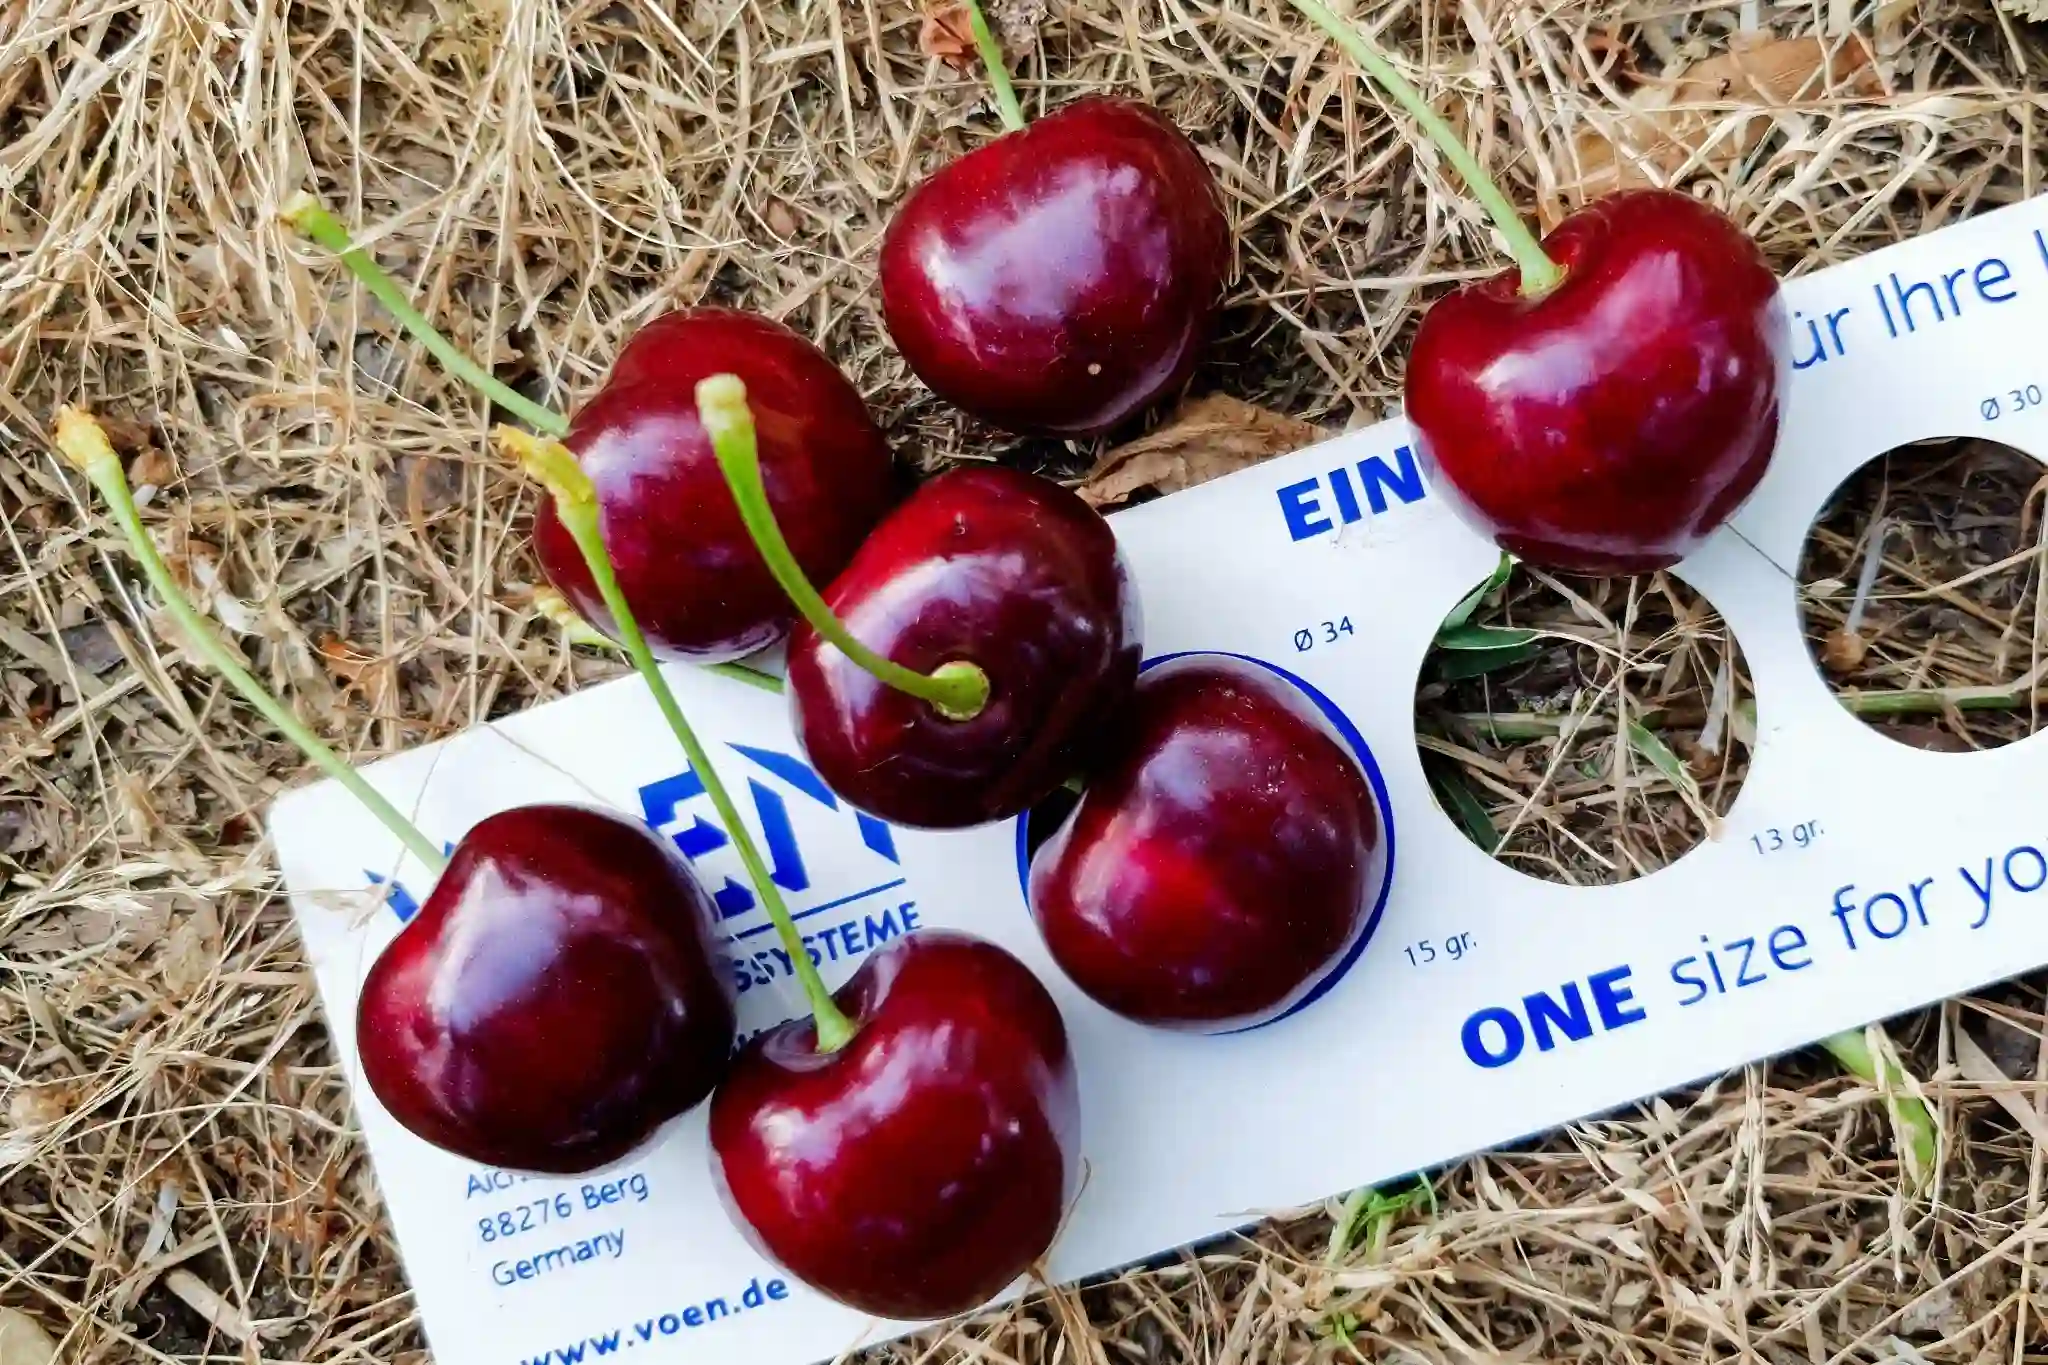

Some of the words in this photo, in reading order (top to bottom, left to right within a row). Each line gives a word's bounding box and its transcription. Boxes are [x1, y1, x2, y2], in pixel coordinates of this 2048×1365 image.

[1276, 445, 1426, 542] EIN
[1873, 258, 2018, 339] Ihre
[2007, 384, 2042, 412] 30
[1321, 615, 1354, 643] 34
[1749, 828, 1784, 855] 13
[1792, 819, 1825, 848] gr.
[1403, 939, 1436, 967] 15
[1445, 931, 1478, 961] gr.
[1460, 963, 1647, 1069] ONE
[1670, 924, 1813, 1006] size
[1830, 876, 1934, 950] for
[1958, 836, 2048, 930] yo
[478, 1192, 572, 1242] 88276
[581, 1172, 648, 1210] Berg
[492, 1228, 625, 1286] Germany
[520, 1277, 790, 1365] www.voen.de
